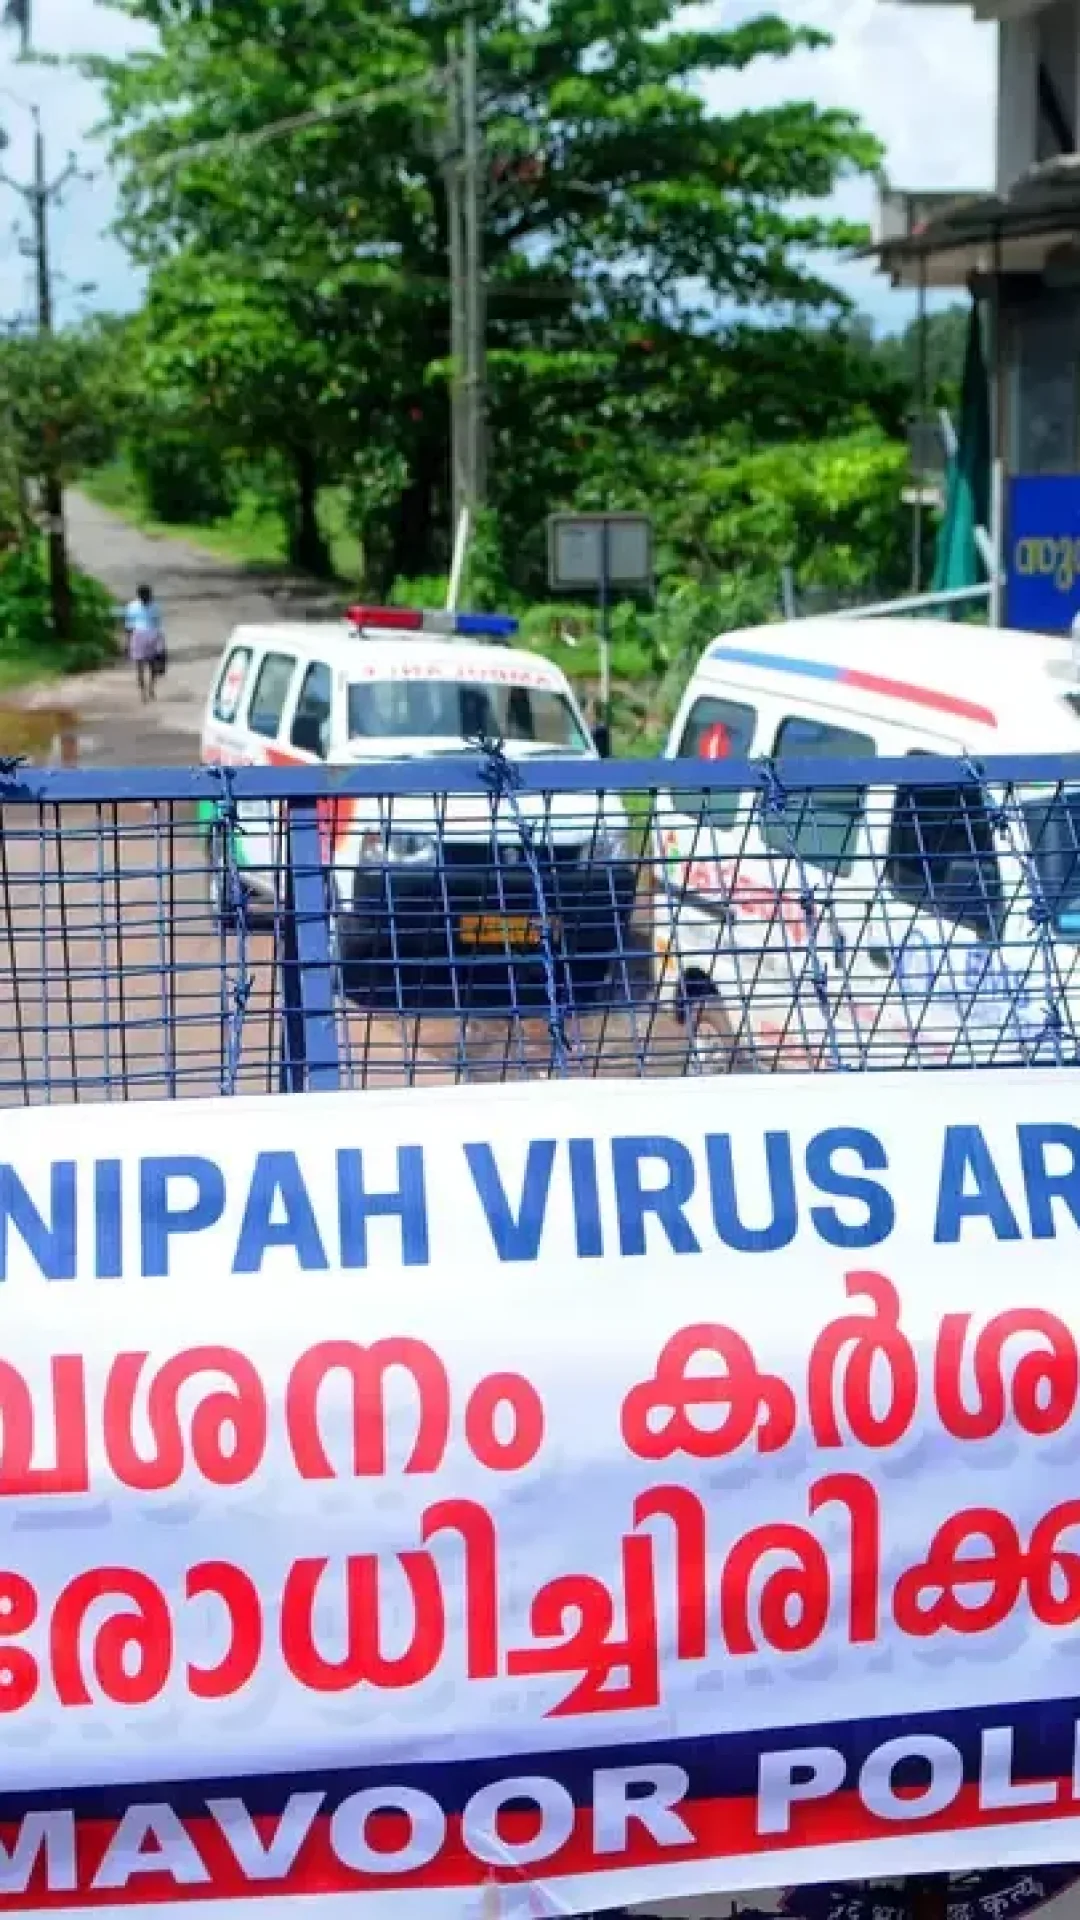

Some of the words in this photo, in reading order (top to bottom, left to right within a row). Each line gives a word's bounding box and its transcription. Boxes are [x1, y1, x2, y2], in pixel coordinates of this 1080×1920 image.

[0, 1146, 430, 1281] NIPAH
[464, 1126, 895, 1262] VIRUS
[933, 1121, 1080, 1243] AR
[0, 1765, 695, 1894] MAVOOR
